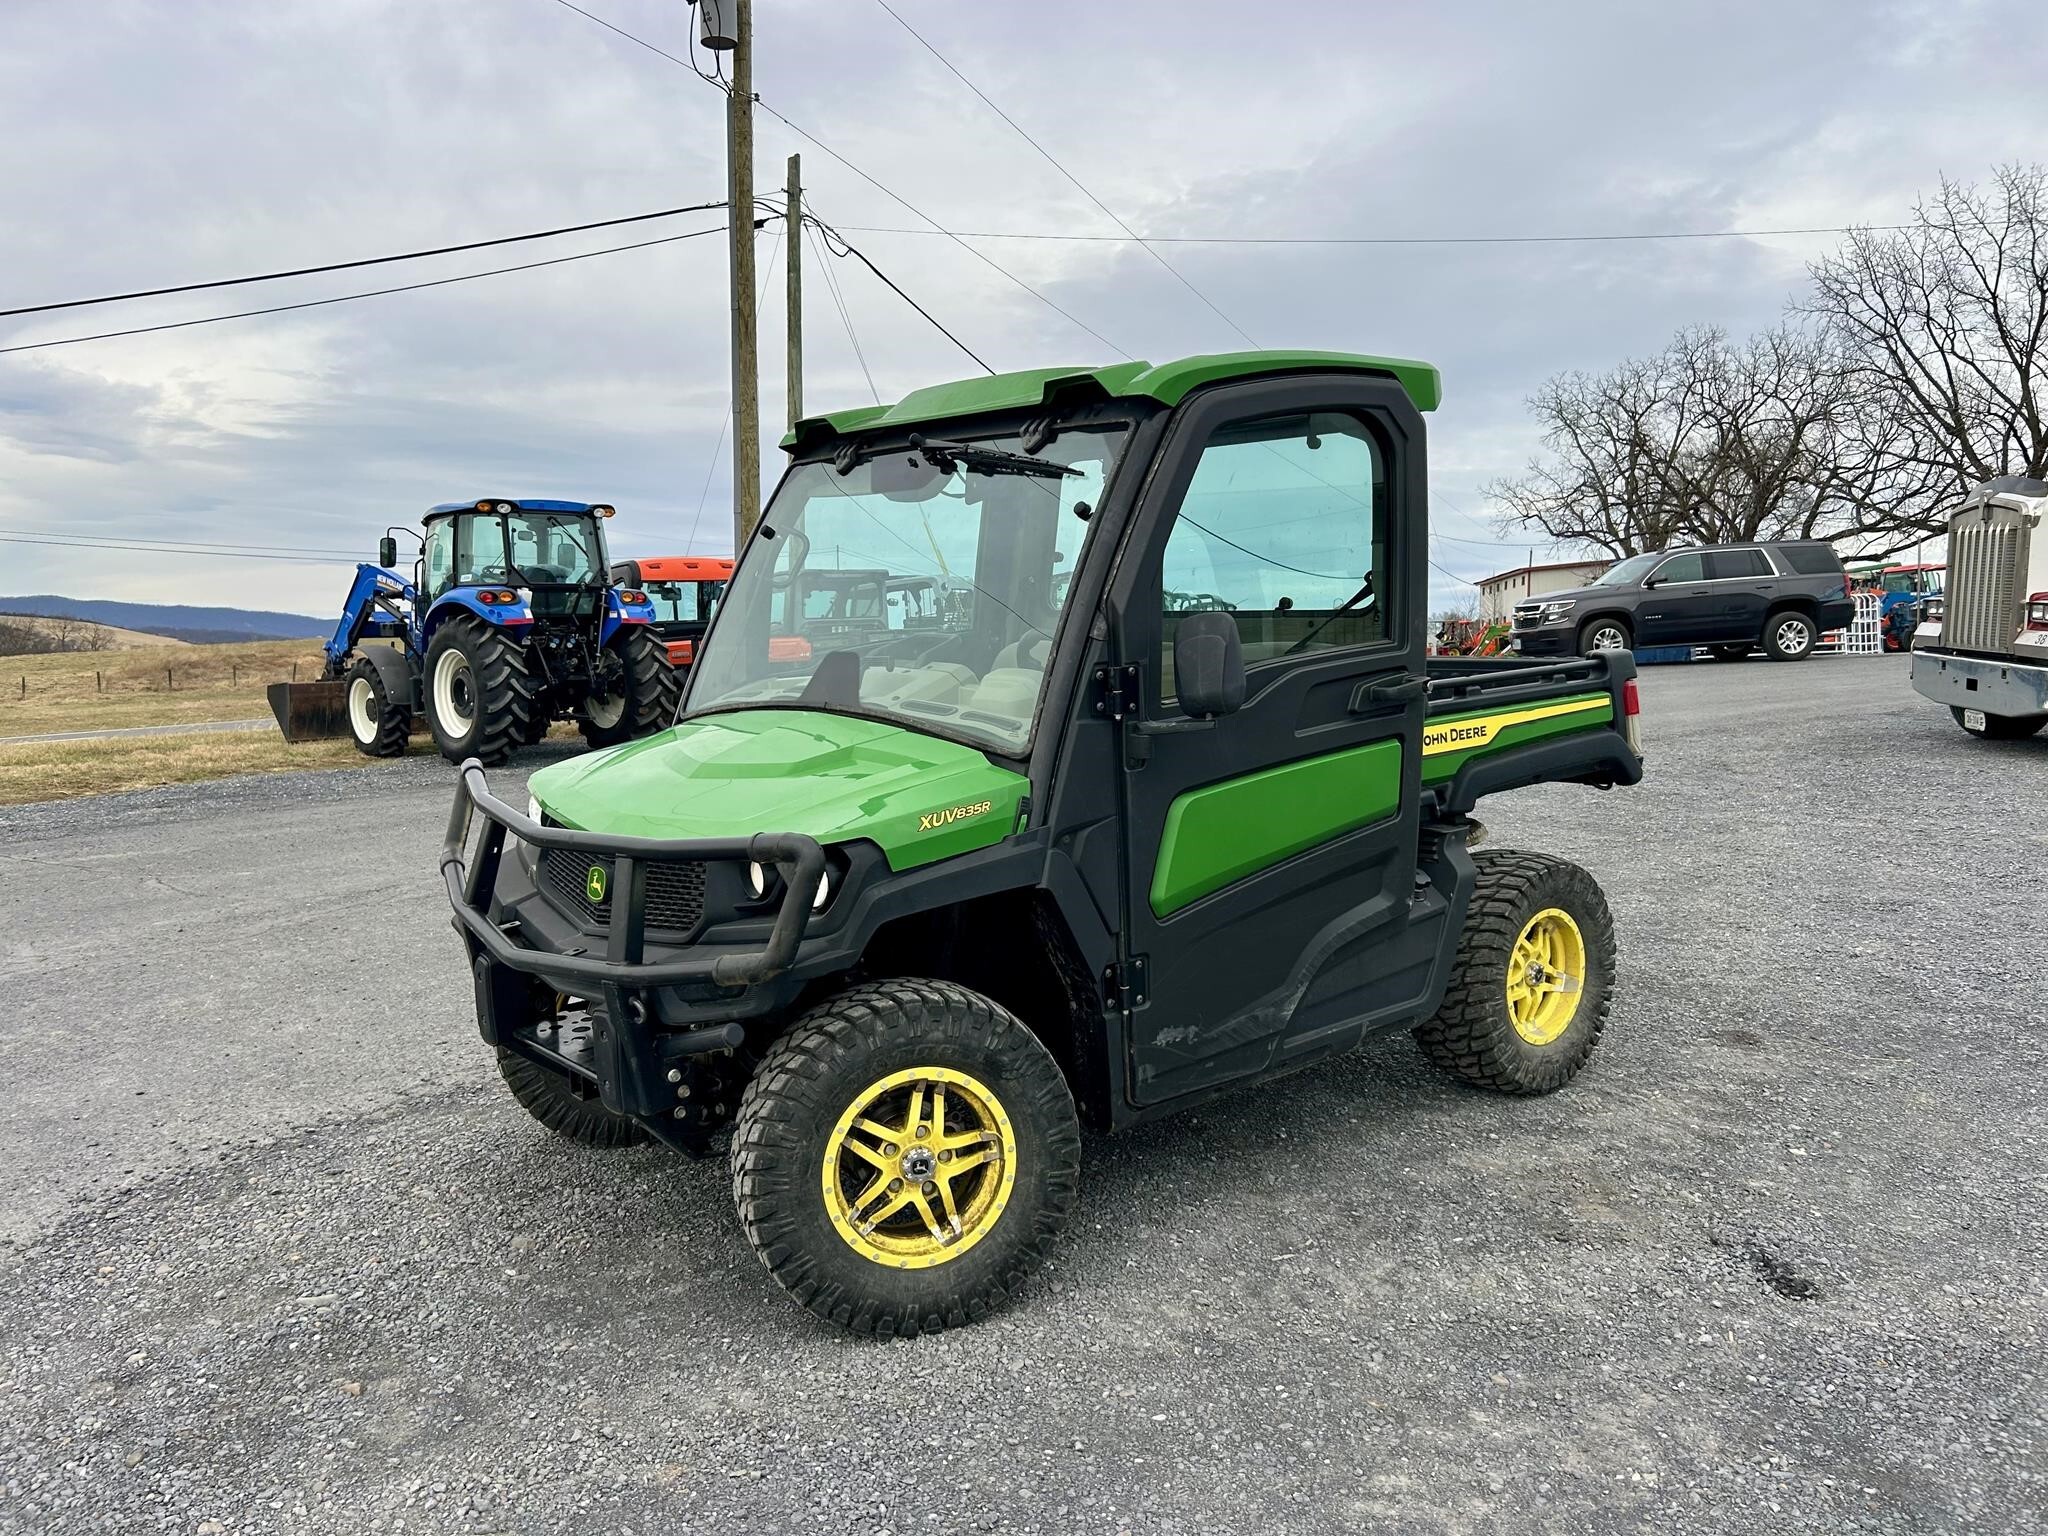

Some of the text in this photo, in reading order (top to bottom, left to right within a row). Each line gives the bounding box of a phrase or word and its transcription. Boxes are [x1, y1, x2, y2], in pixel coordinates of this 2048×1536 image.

[1423, 725, 1487, 746] OHN DEERE
[917, 800, 992, 832] XUV835R
